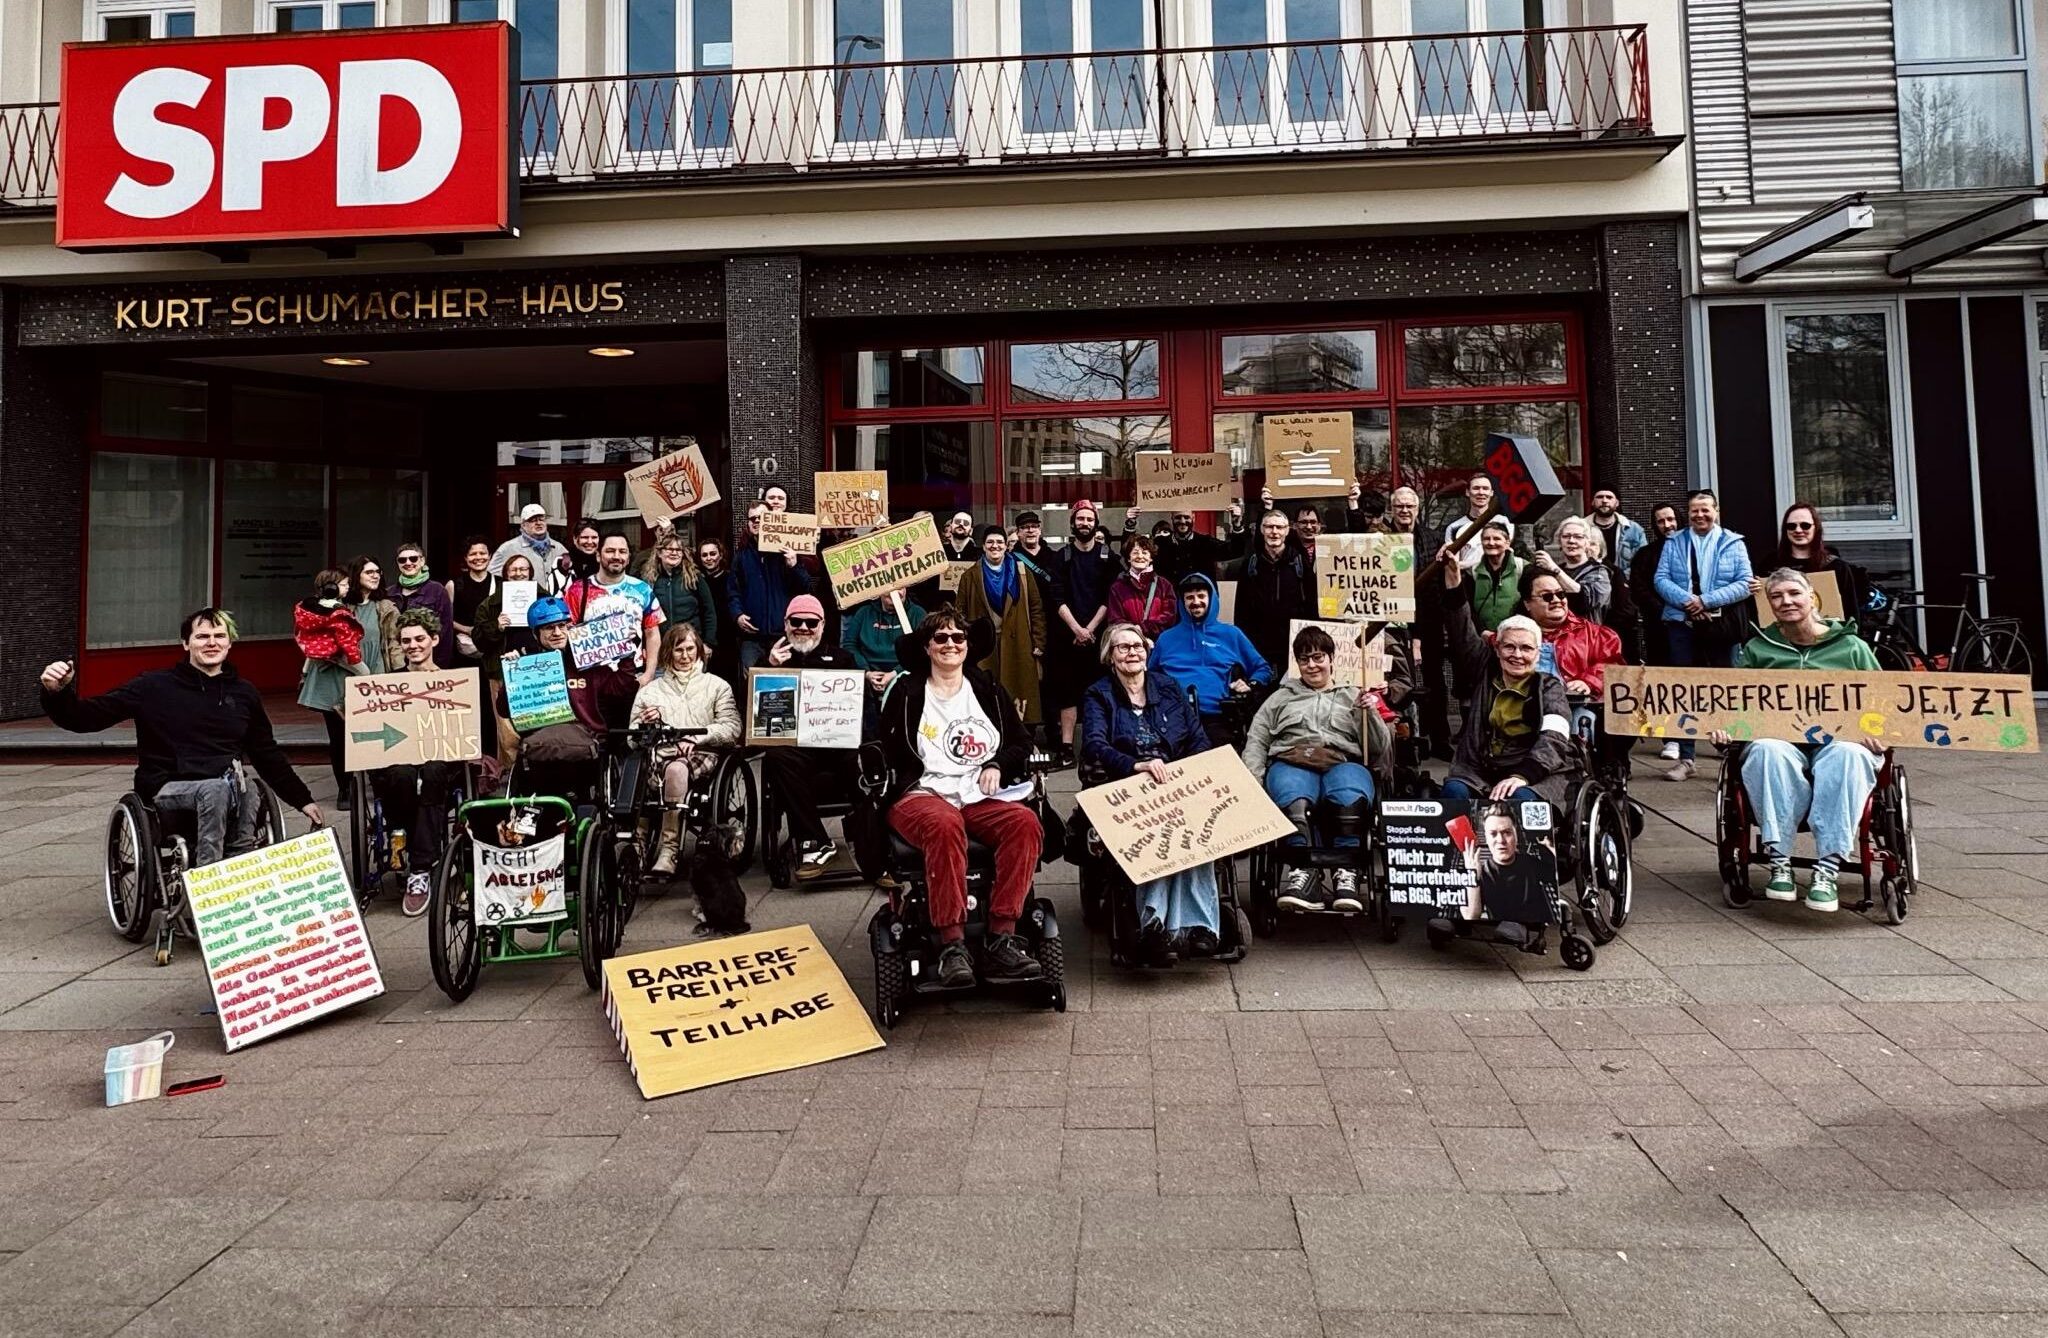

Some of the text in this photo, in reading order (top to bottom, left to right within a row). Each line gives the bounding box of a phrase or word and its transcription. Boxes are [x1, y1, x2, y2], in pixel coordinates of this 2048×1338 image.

[104, 58, 463, 220] SPD
[752, 457, 778, 476] 10
[1173, 471, 1188, 481] IST
[1486, 441, 1537, 514] BGG
[664, 479, 693, 500] BGG
[826, 490, 861, 500] IST EIN
[763, 513, 788, 524] EINE
[818, 499, 884, 514] MENSCHEN
[761, 525, 817, 538] GESELLSCHAFT
[833, 513, 875, 527] RECHT
[762, 534, 782, 544] FÜR
[826, 520, 933, 575] EVERYBODY
[851, 543, 914, 578] HATES
[1333, 555, 1382, 571] MEHR
[835, 548, 948, 599] KOPFSTEINPFLASTER
[1325, 573, 1397, 590] TEILHABE
[1352, 588, 1380, 603] FÜR
[569, 627, 589, 641] DAS
[609, 615, 625, 629] IST
[572, 627, 628, 654] MAXIMALE
[576, 642, 633, 666] VERACHTUNG
[820, 677, 857, 694] SPD
[1609, 681, 2026, 718] BARRIEREFREIHEIT JETZT
[415, 708, 473, 741] MIT
[417, 734, 482, 762] UNS
[1105, 787, 1133, 808] WIR
[1133, 784, 1231, 832] ZUGANG ZU
[1386, 825, 1427, 835] Stoppt die
[1386, 836, 1451, 846] Diskriminierung!
[481, 847, 541, 867] FIGHT
[1387, 848, 1445, 866] Pflicht zur
[1388, 867, 1477, 887] Barrierefreiheit
[197, 870, 343, 924] wurde ich von der
[1389, 886, 1467, 908] ins BGG, jetzt!
[296, 919, 326, 936] den
[329, 910, 354, 923] ich
[205, 932, 238, 952] und
[244, 922, 275, 939] aus
[217, 979, 242, 994] die
[342, 936, 364, 950] zu
[280, 974, 299, 986] in
[304, 948, 367, 977] welcher
[626, 945, 811, 989] BARRIERE-
[646, 961, 797, 1004] FREIHEIT
[223, 1000, 272, 1024] Nazis
[228, 1020, 259, 1040] das
[261, 1000, 311, 1027] Leben
[650, 992, 835, 1048] TEILHABE
